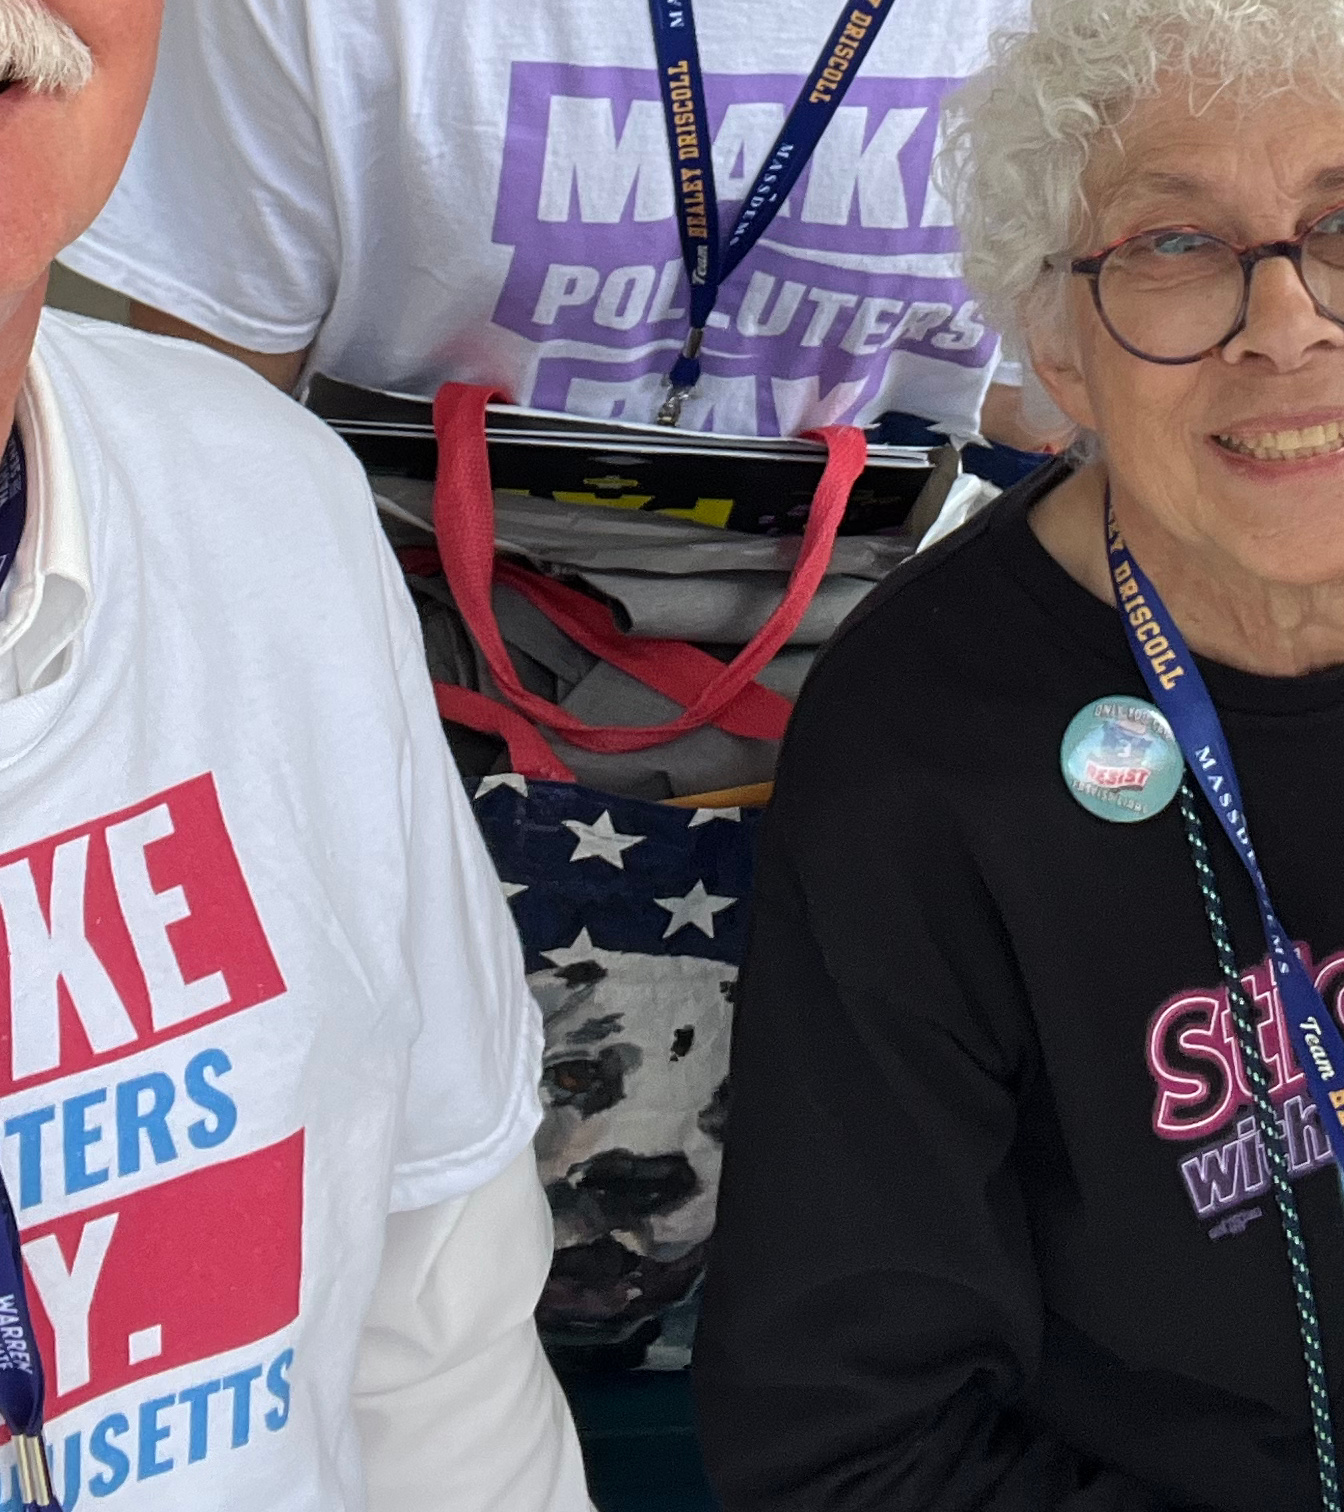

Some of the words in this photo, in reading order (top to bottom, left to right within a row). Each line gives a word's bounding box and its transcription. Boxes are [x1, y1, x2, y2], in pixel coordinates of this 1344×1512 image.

[808, 9, 875, 106] DRISCOLL
[668, 59, 699, 161] DRISCOLL
[536, 91, 960, 232] MAK
[685, 161, 709, 240] HEALEY
[1112, 560, 1189, 691] DRISCOLL
[1298, 1015, 1337, 1082] Team
